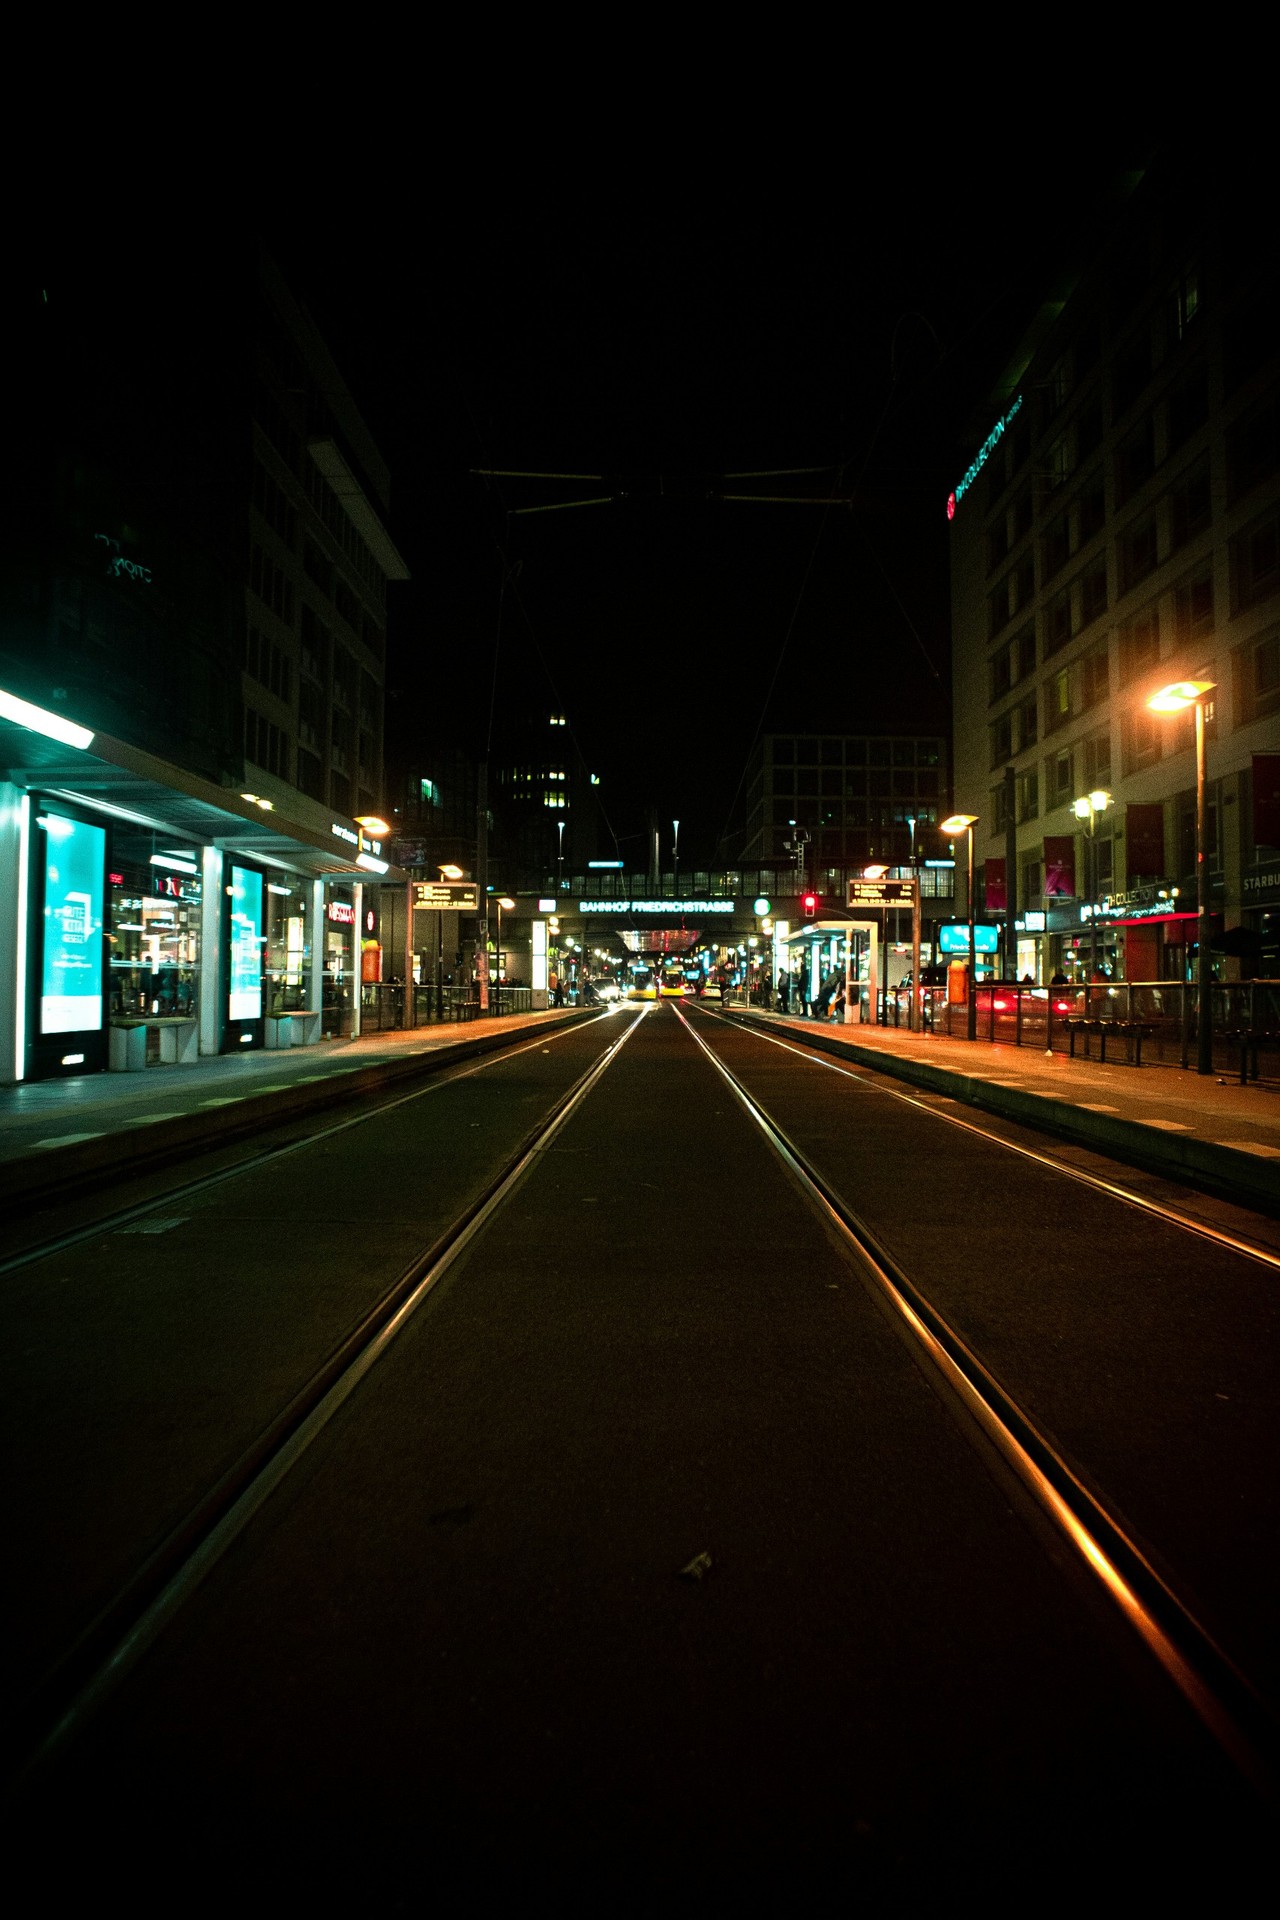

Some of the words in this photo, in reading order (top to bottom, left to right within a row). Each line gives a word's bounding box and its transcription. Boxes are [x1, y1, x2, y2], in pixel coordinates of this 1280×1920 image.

[1243, 873, 1280, 891] STARBU
[579, 902, 630, 912] BAHNHOF
[631, 902, 735, 913] FRIEDRICHSTRASSE
